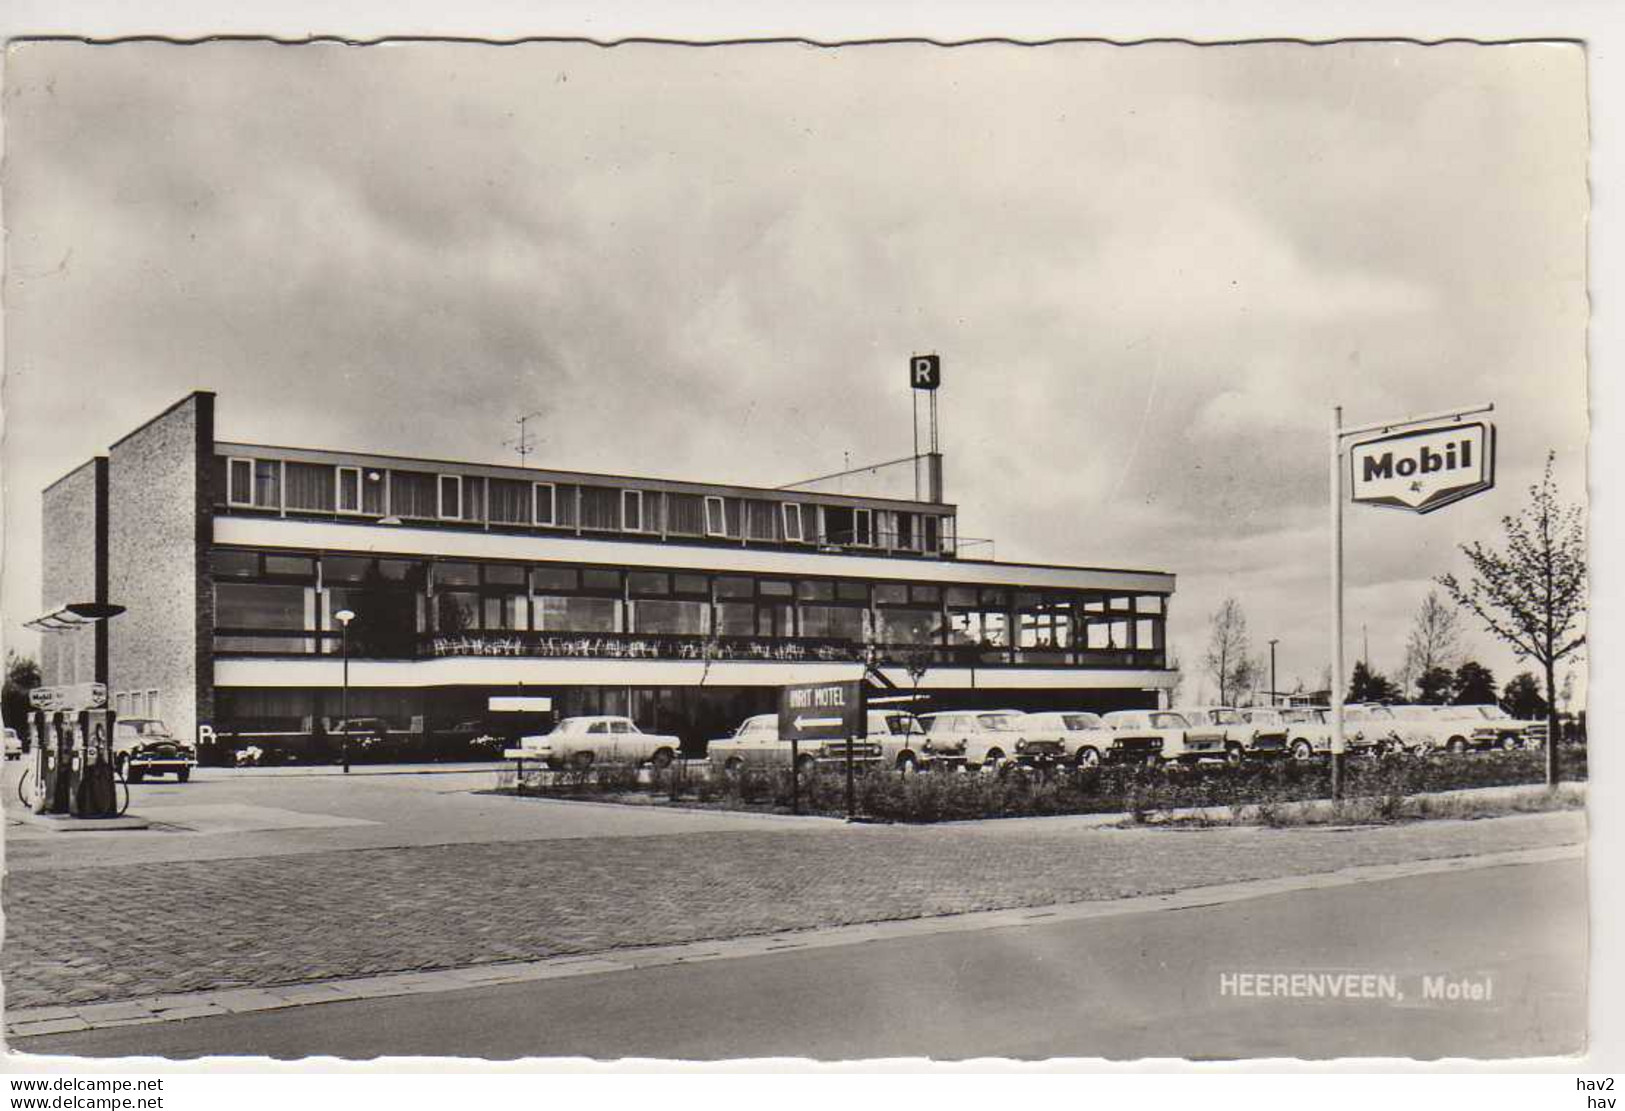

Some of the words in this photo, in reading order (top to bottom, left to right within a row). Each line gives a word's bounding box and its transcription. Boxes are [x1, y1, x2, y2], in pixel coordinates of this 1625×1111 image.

[916, 359, 931, 383] R
[1363, 440, 1471, 482] Mobil
[815, 686, 845, 707] MOTEL
